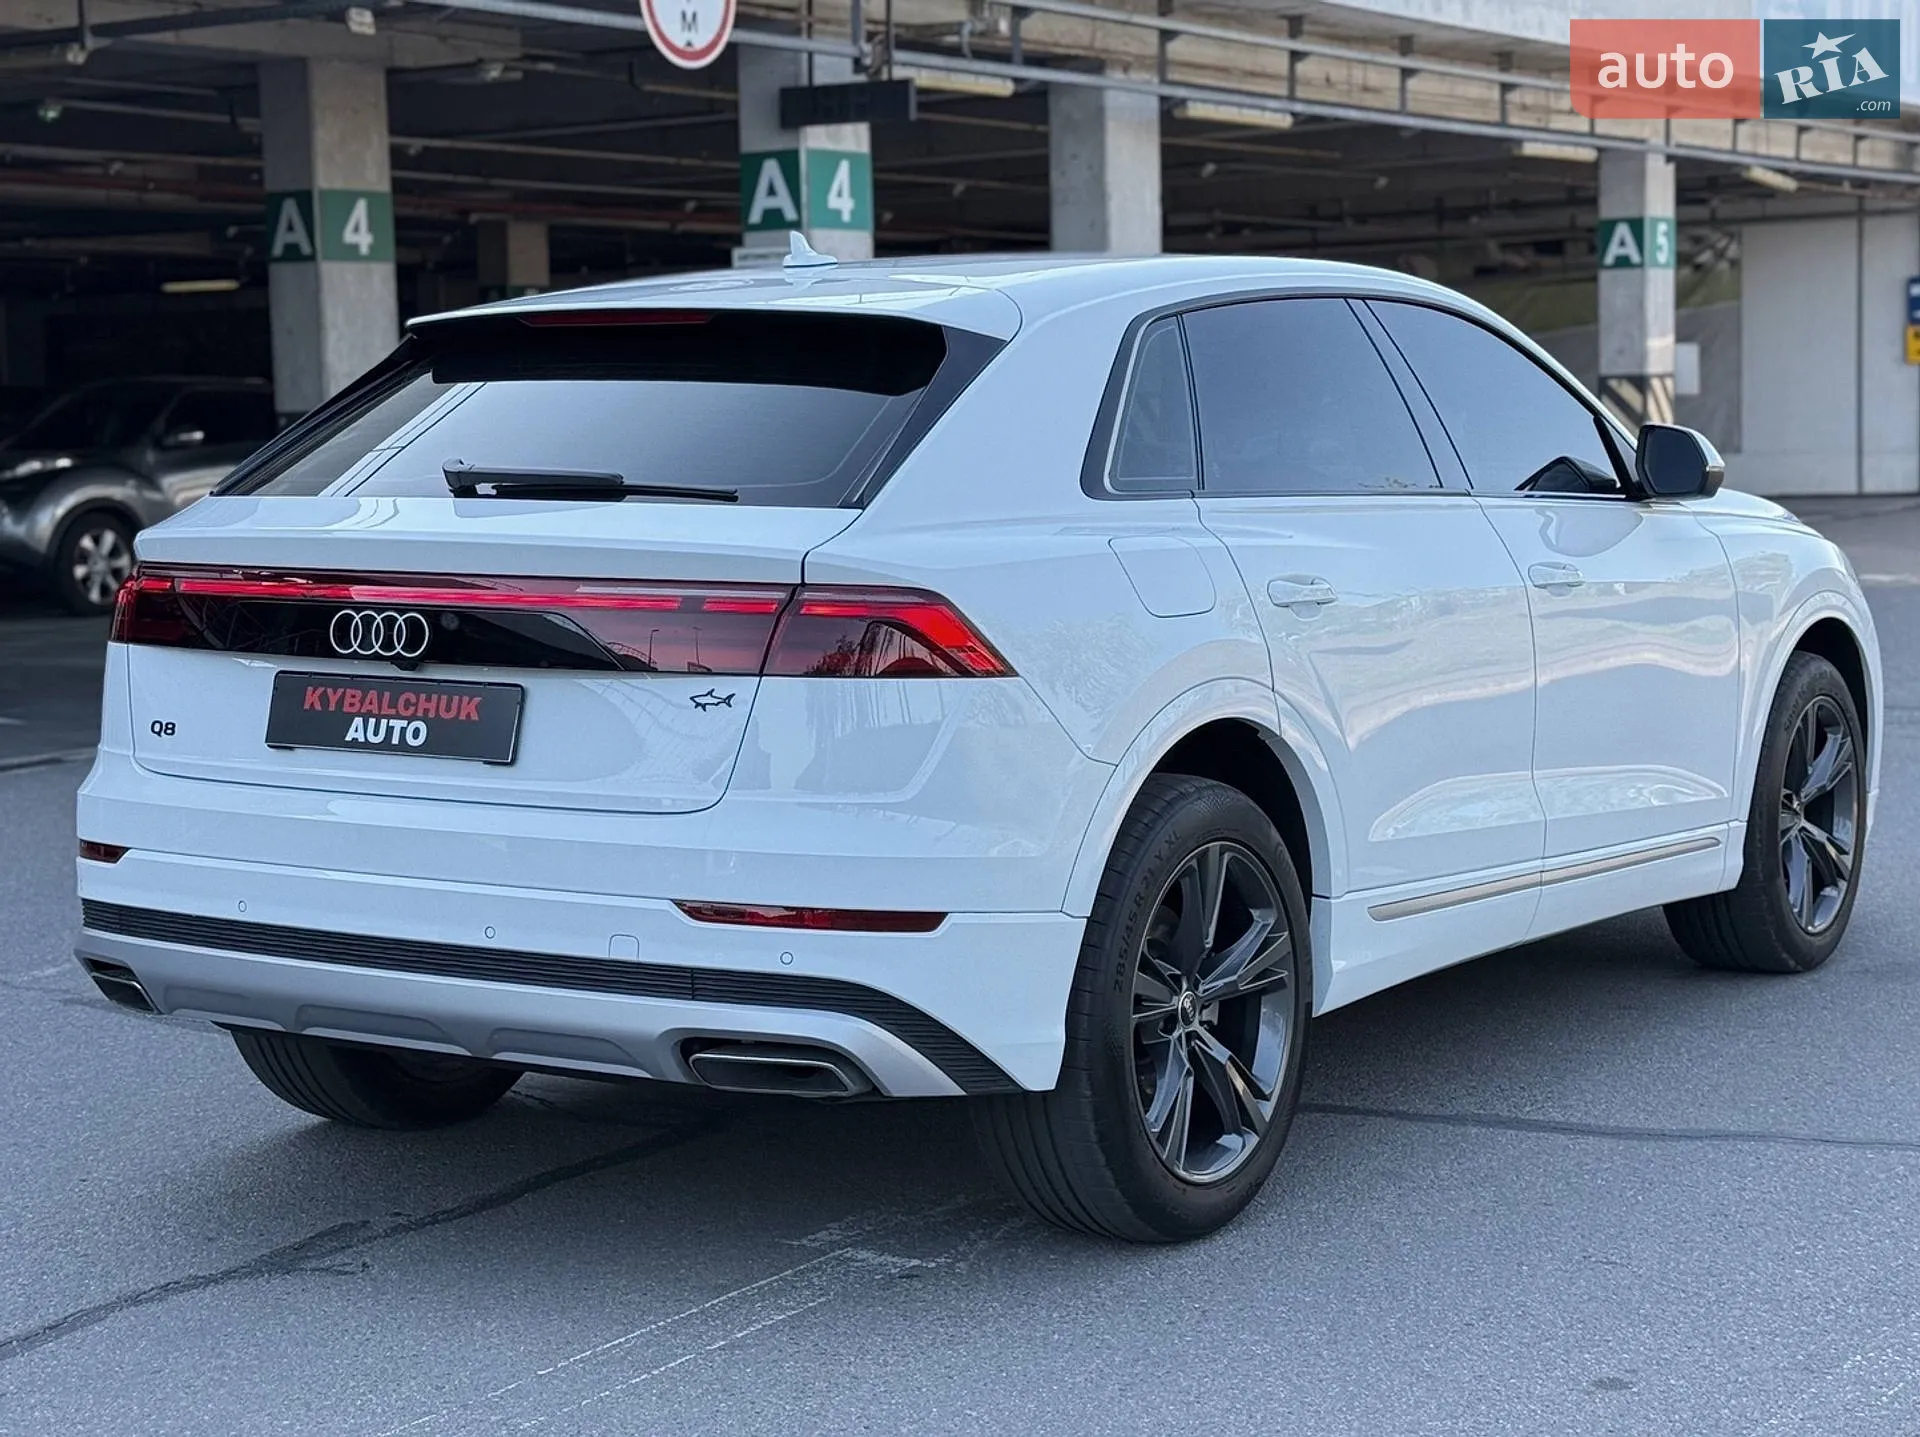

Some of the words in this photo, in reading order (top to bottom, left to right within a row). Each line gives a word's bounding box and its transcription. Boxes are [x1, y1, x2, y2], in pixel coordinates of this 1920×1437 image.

[749, 158, 799, 225] A
[827, 159, 855, 223] 4
[271, 198, 313, 257] A
[342, 197, 374, 256] 4
[1603, 221, 1642, 266] A
[1655, 221, 1669, 265] 5
[303, 686, 482, 721] KYBALCHUK
[150, 719, 177, 738] Q8
[345, 717, 427, 747] AUTO
